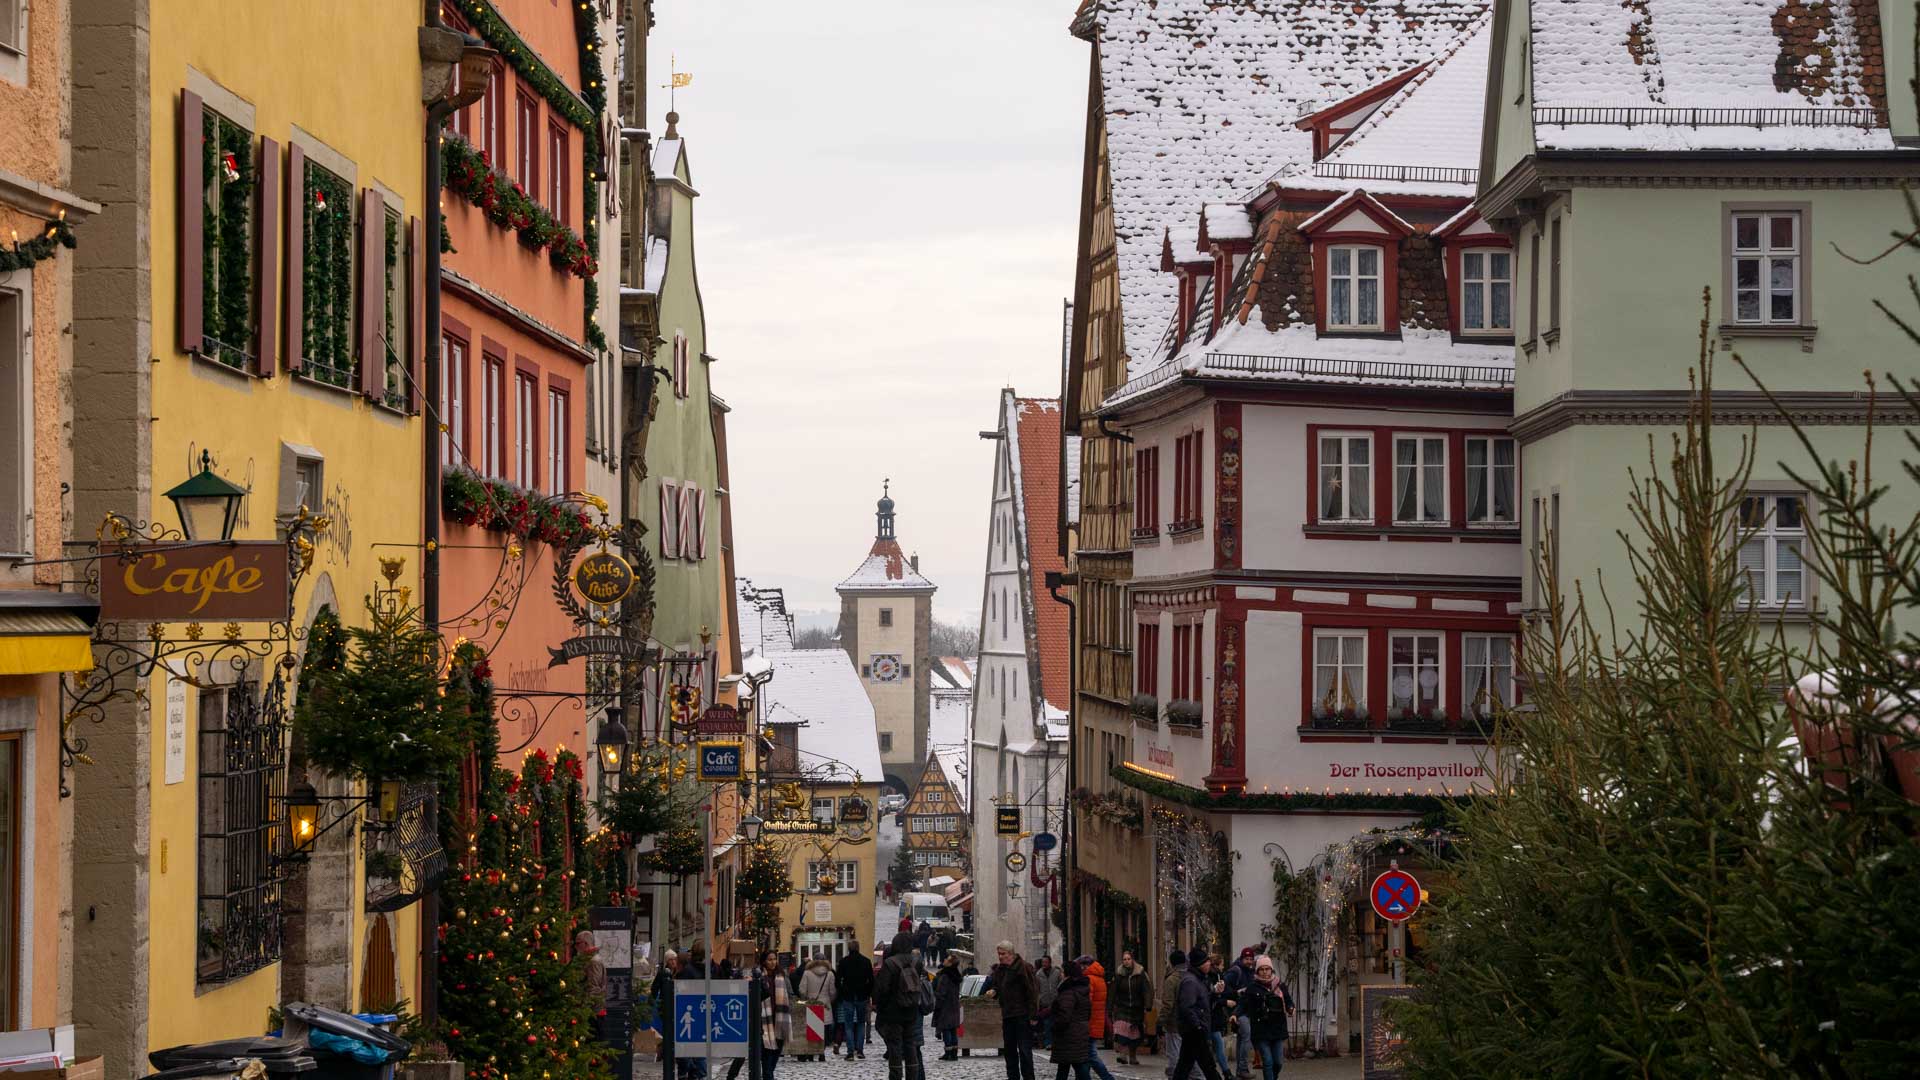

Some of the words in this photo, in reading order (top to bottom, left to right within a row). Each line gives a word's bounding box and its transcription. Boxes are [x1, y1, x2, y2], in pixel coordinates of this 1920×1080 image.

[123, 552, 264, 614] Café
[564, 639, 642, 657] RESTAURANT
[708, 711, 734, 719] WEIN
[1329, 763, 1360, 778] Der
[1363, 762, 1484, 781] Rosenpavillon
